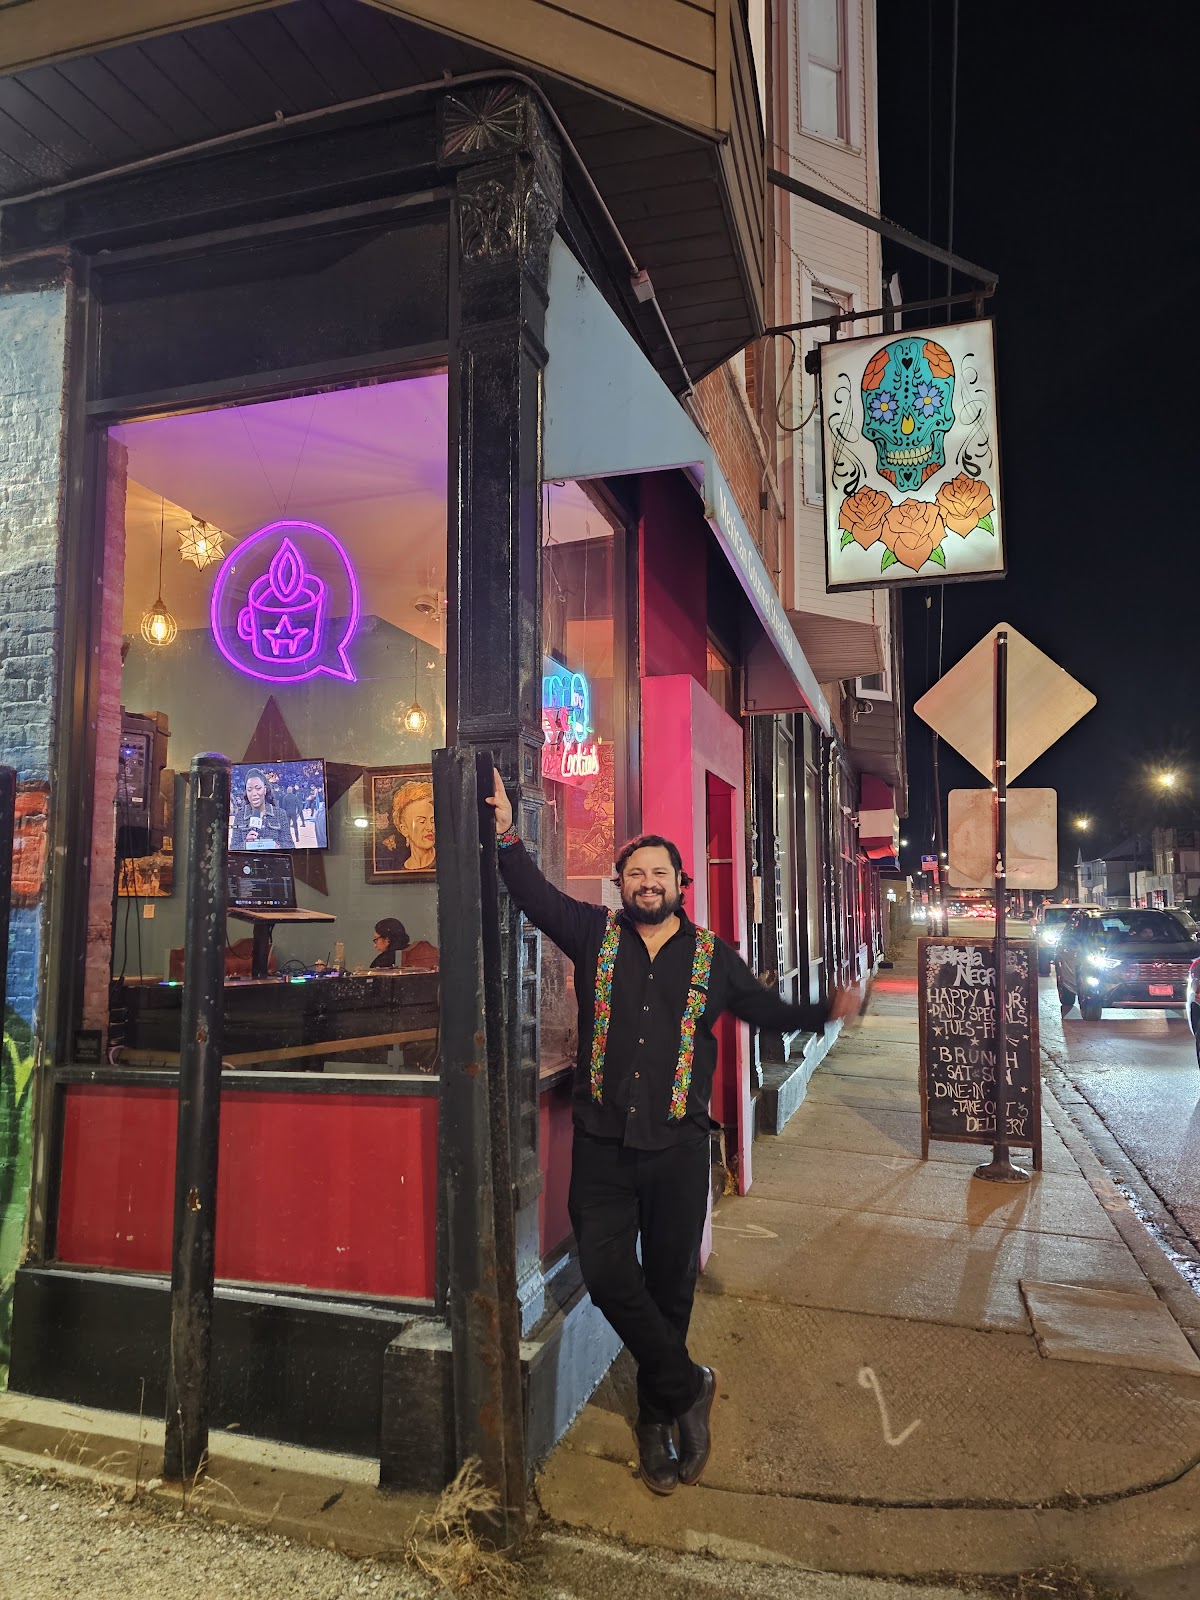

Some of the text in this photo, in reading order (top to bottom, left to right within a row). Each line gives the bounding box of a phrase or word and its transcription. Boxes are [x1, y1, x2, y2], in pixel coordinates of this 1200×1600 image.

[720, 487, 793, 659] Mexican Gourmet Street Food
[953, 964, 996, 987] NEGR
[927, 987, 980, 1007] HAPPY
[931, 1003, 966, 1020] DAILY
[939, 1046, 1019, 1069] BRUNH
[947, 1064, 973, 1081] SAT
[954, 1099, 983, 1115] TAKE
[984, 1100, 1016, 1117] OT
[966, 1115, 1027, 1137] DELIERY
